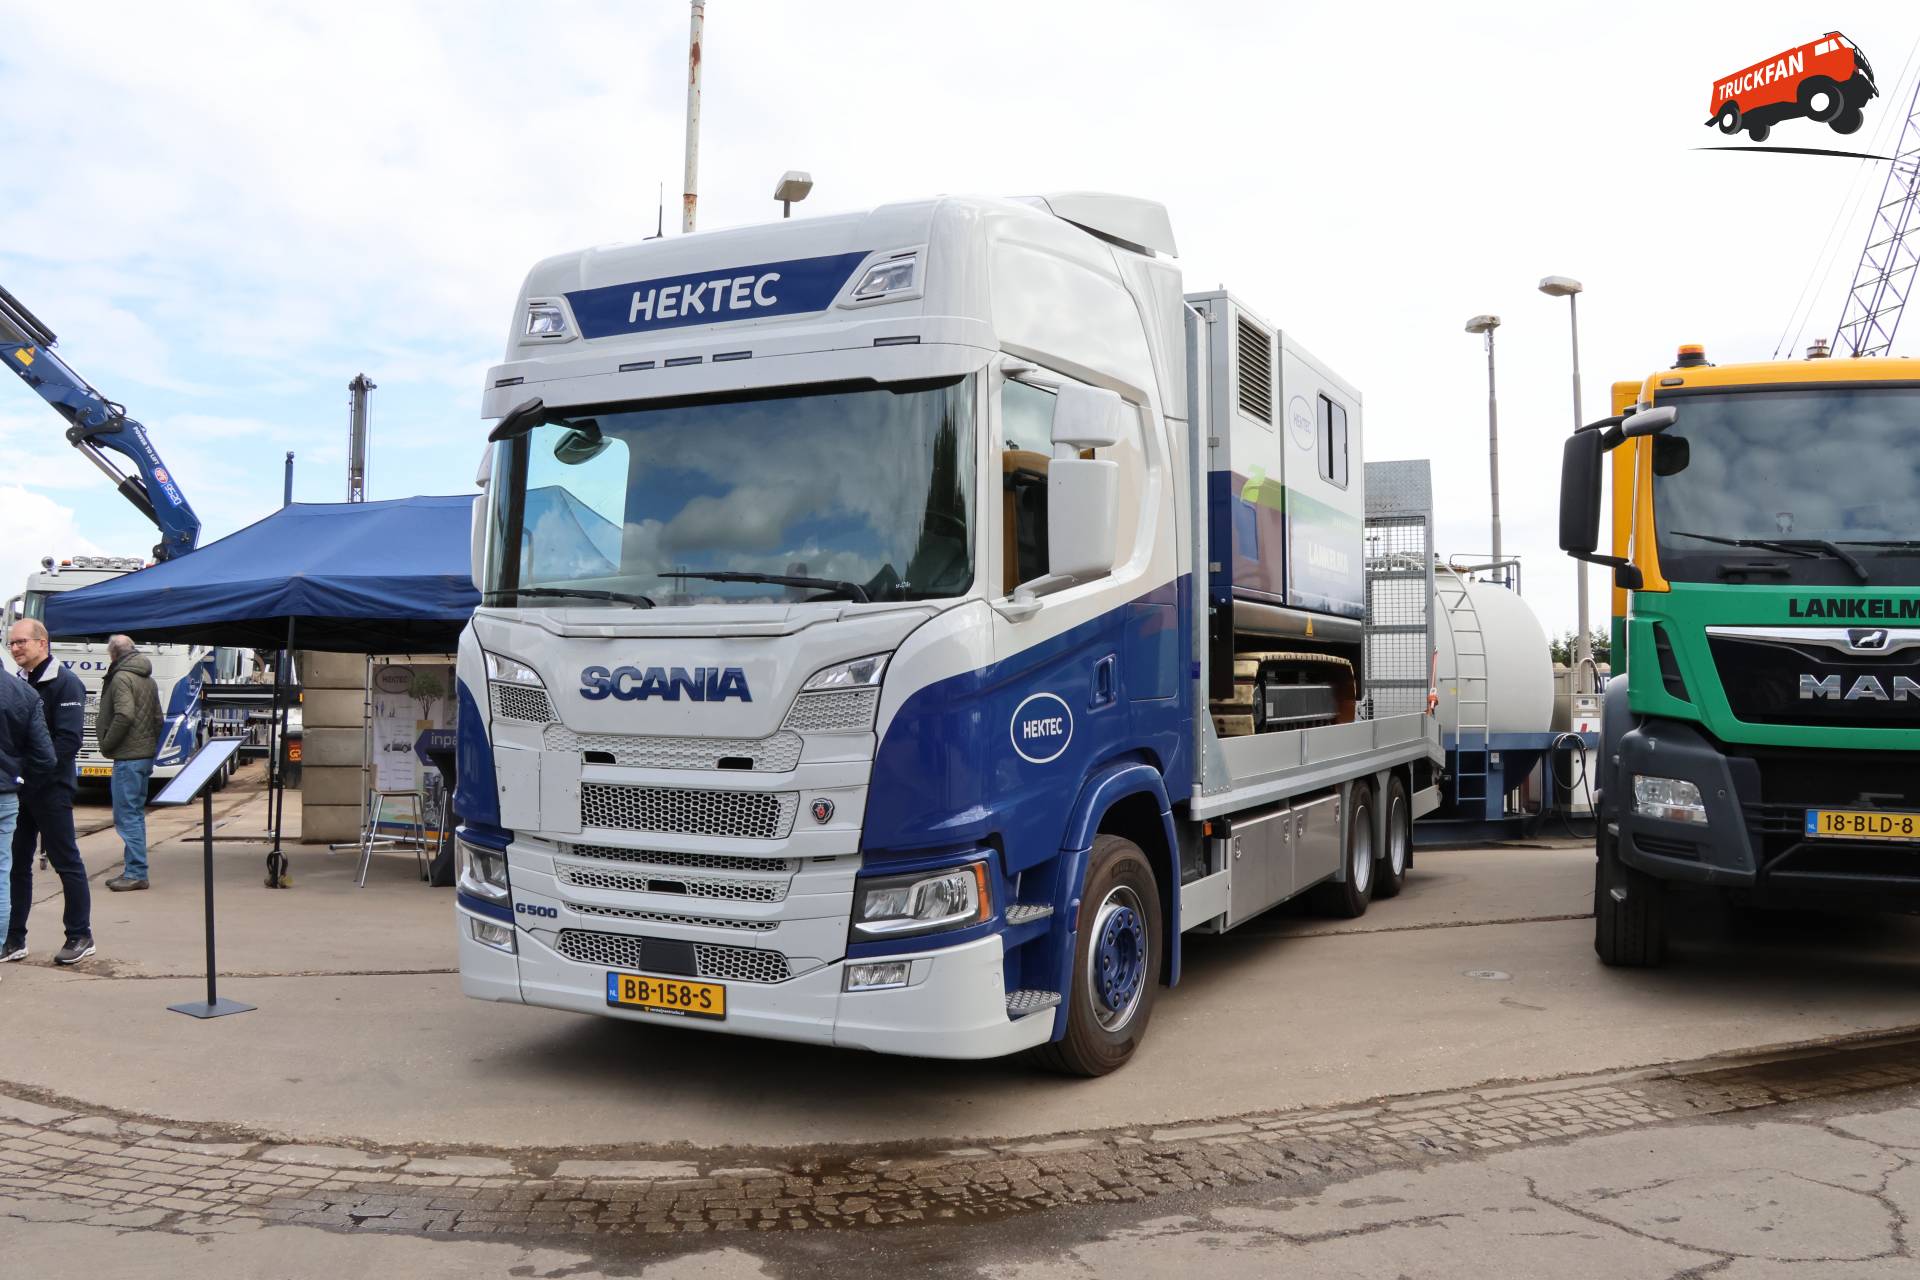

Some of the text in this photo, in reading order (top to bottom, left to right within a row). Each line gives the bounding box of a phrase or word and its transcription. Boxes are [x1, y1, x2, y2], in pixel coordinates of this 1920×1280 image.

[629, 273, 781, 323] HEKTEC
[61, 660, 107, 671] VOL
[580, 665, 753, 703] SCANIA
[1799, 673, 1920, 701] MAN
[1023, 716, 1063, 739] HEKTEC
[1826, 814, 1913, 834] 18-BLD-8
[515, 902, 558, 919] G500
[609, 979, 712, 1009] NL BB-158-S
